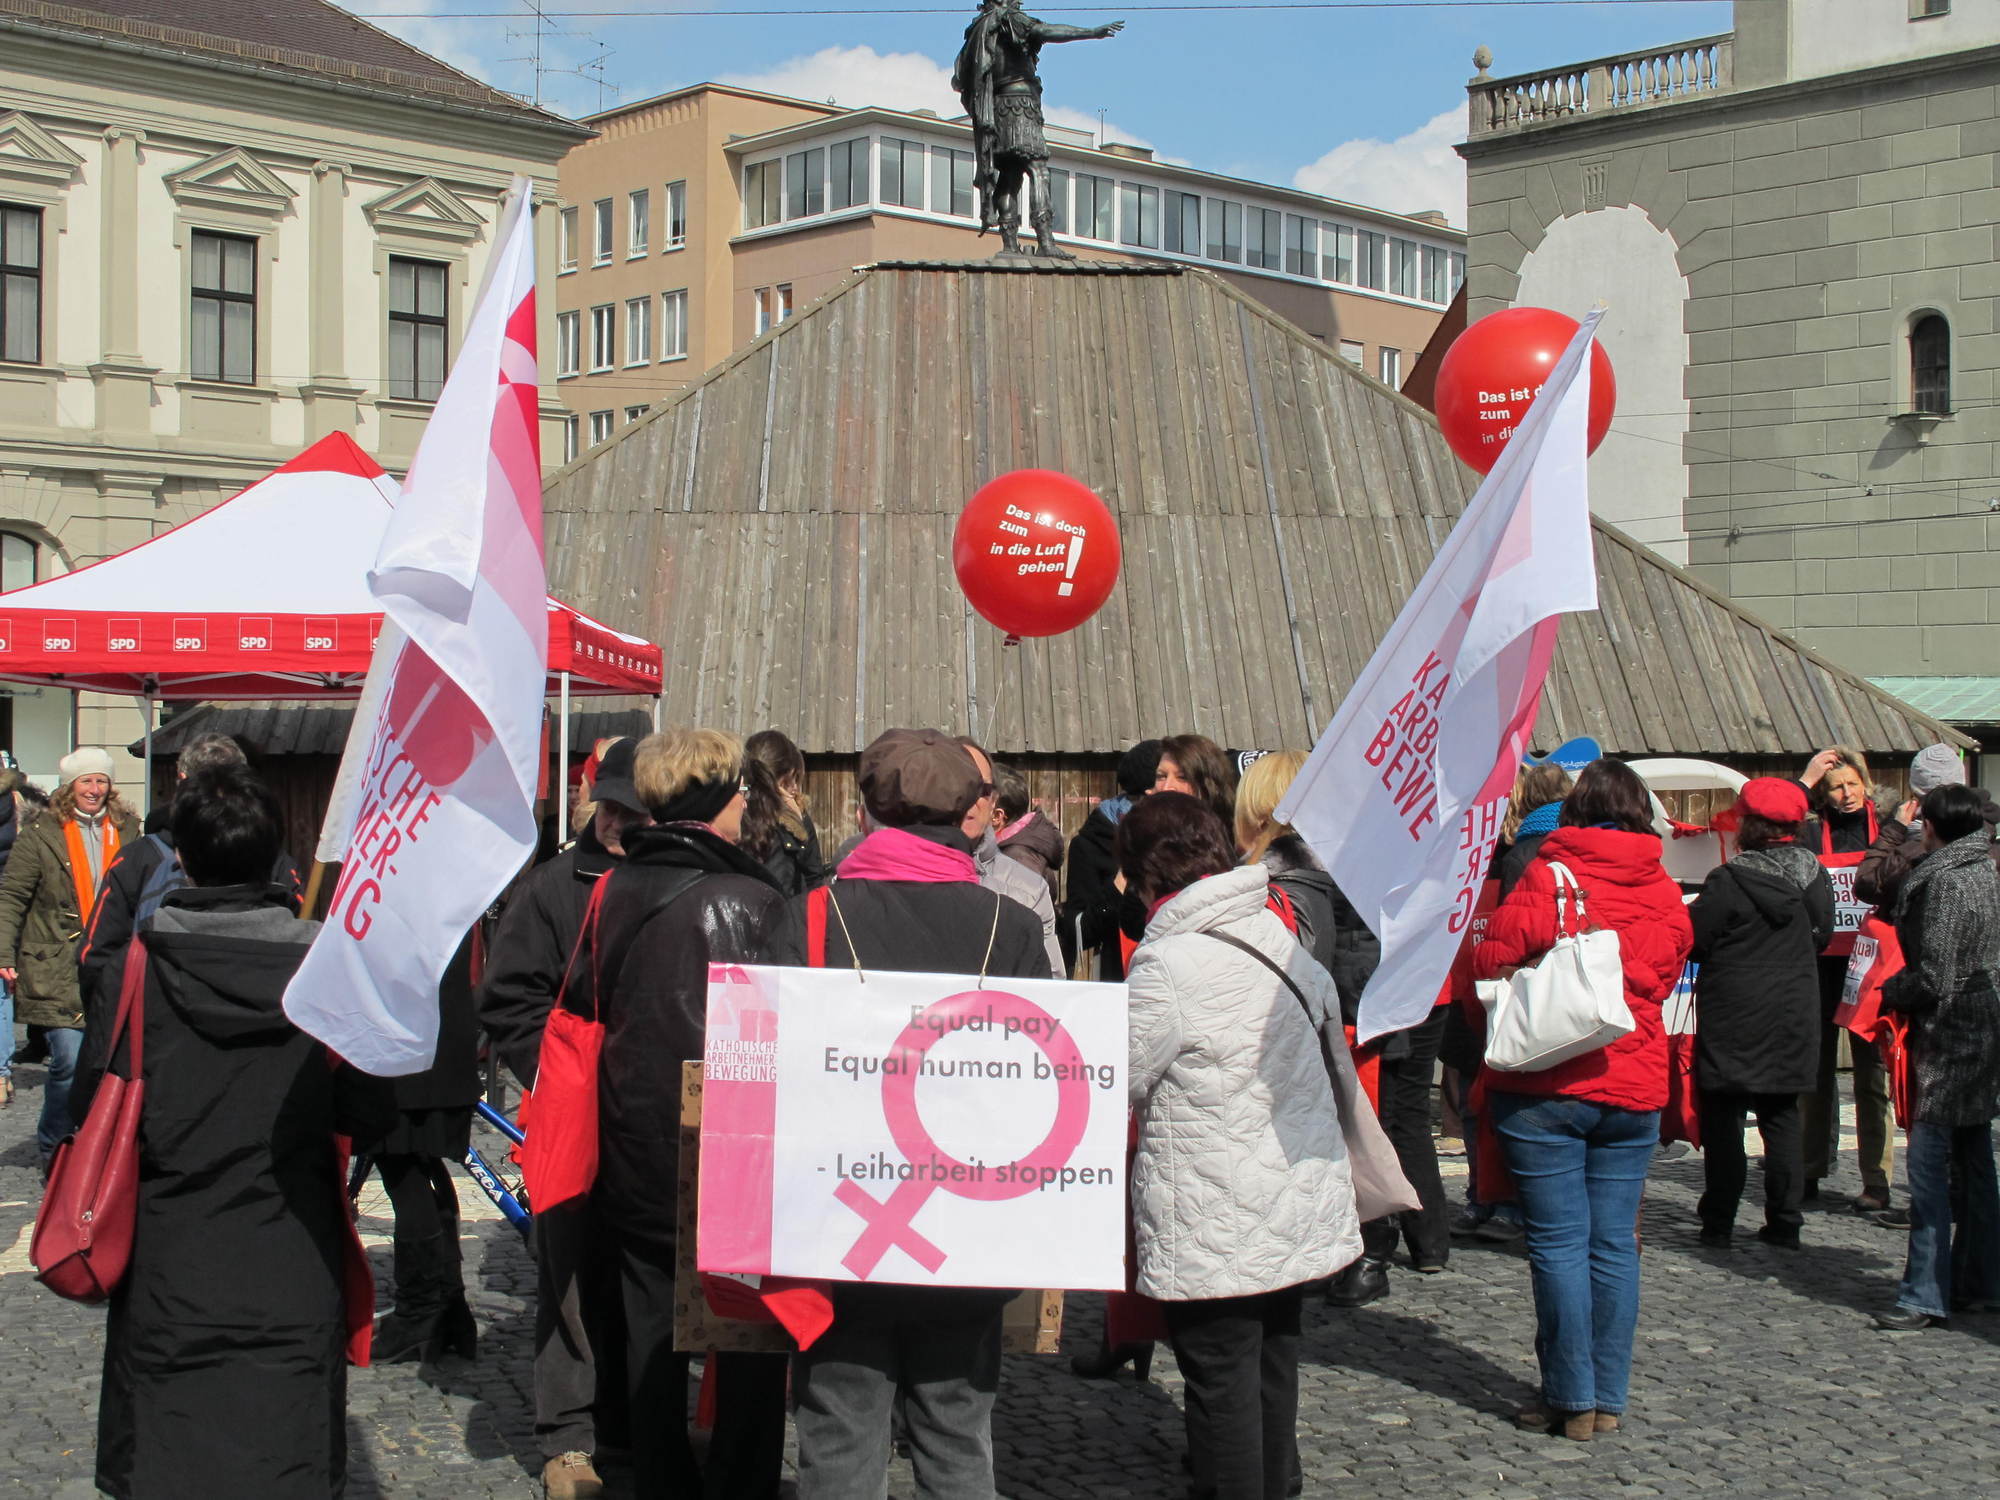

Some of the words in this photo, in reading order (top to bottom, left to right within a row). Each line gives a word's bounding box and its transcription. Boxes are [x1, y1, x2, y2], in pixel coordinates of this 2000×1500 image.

[1478, 391, 1506, 403] Das
[1510, 387, 1530, 401] ist
[1480, 409, 1511, 420] zum
[1482, 433, 1495, 444] in
[1005, 504, 1032, 520] Das
[1034, 512, 1053, 527] ist
[1055, 520, 1086, 537] doch
[999, 520, 1028, 537] zum
[990, 542, 1004, 555] in
[1007, 543, 1031, 556] die
[1034, 543, 1066, 556] Luft
[1017, 560, 1065, 576] gehen
[45, 638, 71, 650] SPD
[110, 638, 136, 650] SPD
[175, 637, 202, 649] SPD
[240, 637, 267, 648] SPD
[306, 638, 332, 649] SPD
[910, 1004, 993, 1039] Equal
[1003, 1014, 1061, 1042] pay
[705, 1040, 779, 1054] KATHOLISCHE
[705, 1063, 777, 1081] BEWEGUNG
[824, 1047, 909, 1082] Equal
[919, 1048, 1022, 1080] human
[1033, 1051, 1116, 1090] being
[836, 1151, 986, 1183] Leiharbeit
[995, 1160, 1114, 1192] stoppen
